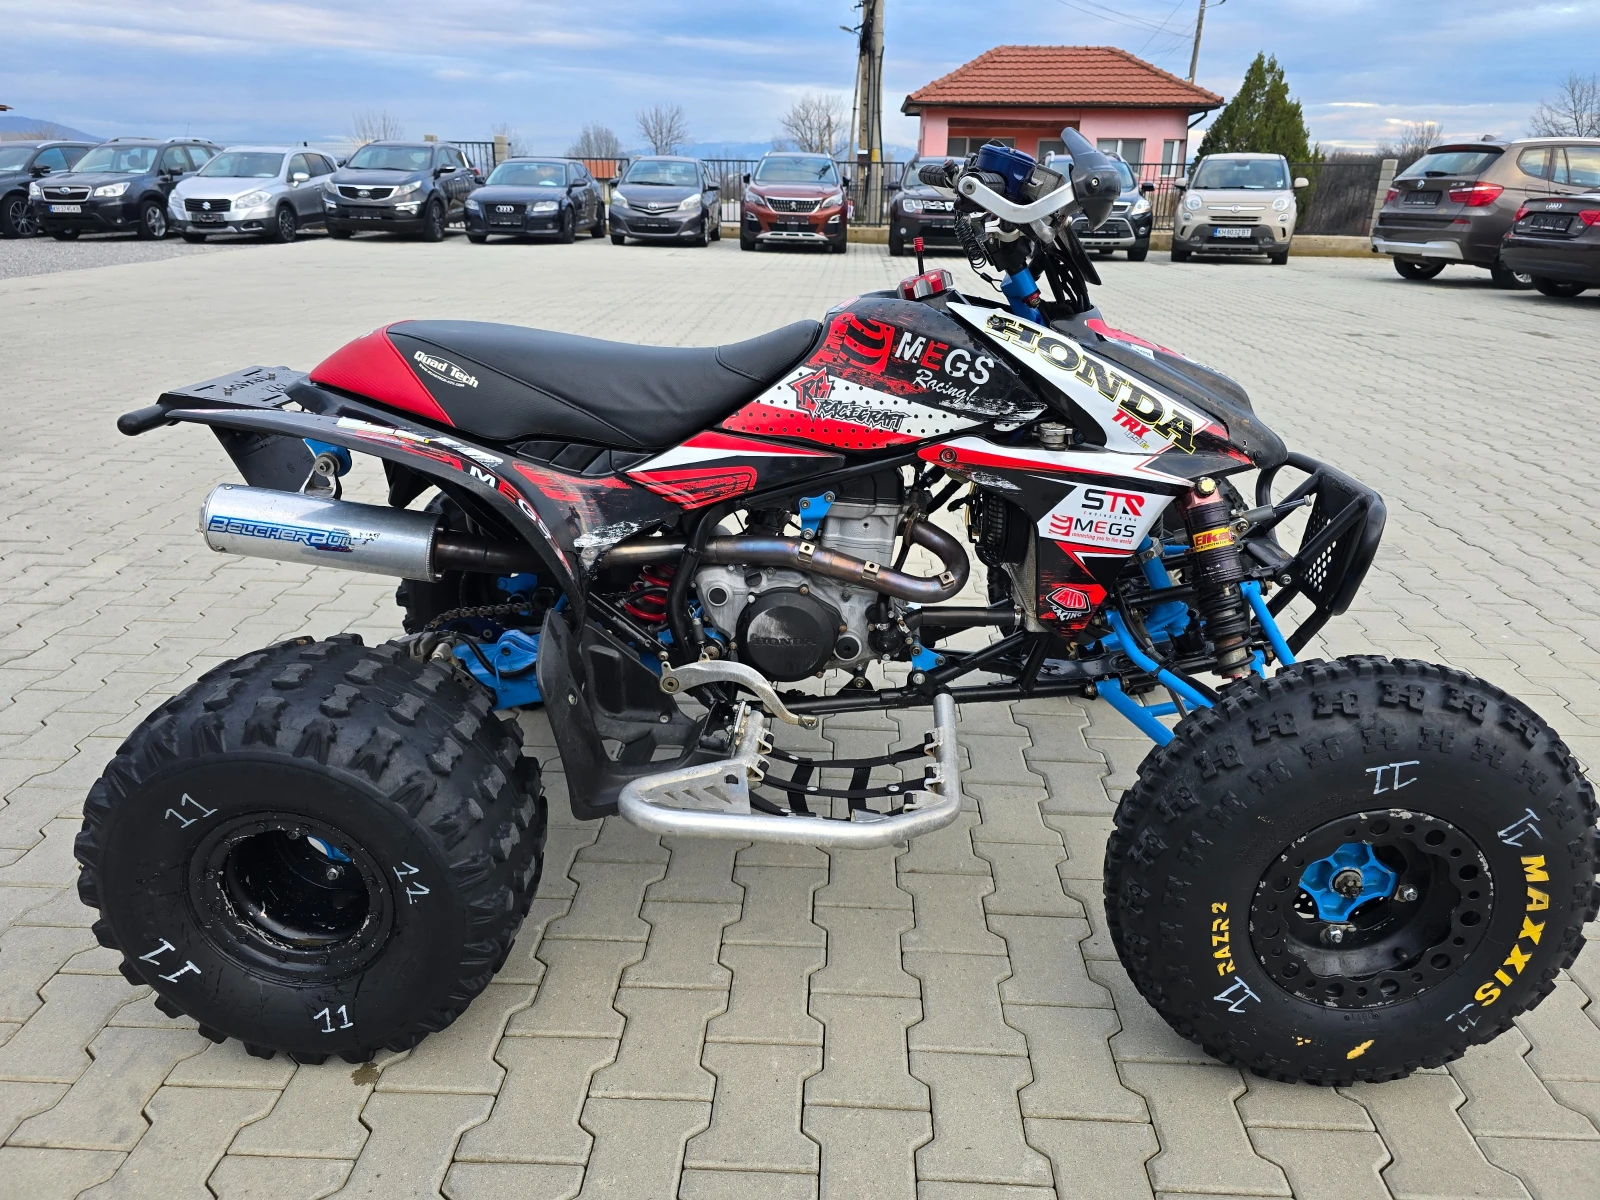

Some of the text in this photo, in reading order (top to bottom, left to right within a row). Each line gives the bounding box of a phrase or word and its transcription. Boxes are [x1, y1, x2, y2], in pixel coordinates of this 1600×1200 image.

[414, 350, 479, 389] Quad Tech
[895, 331, 996, 385] MEGS
[912, 368, 980, 404] Racing!
[984, 314, 1197, 455] HONDA
[815, 398, 912, 431] RACECRAFT
[1112, 408, 1152, 440] TRX
[469, 465, 552, 540] MEGS
[1081, 488, 1145, 517] STR
[1083, 511, 1137, 522] ENGINEERING
[1071, 532, 1096, 541] connecting
[1074, 517, 1137, 538] MEGS
[165, 793, 218, 828] 11
[1211, 901, 1236, 977] RAZR 2
[1473, 853, 1550, 1007] MAXXIS
[313, 1004, 353, 1032] 11
